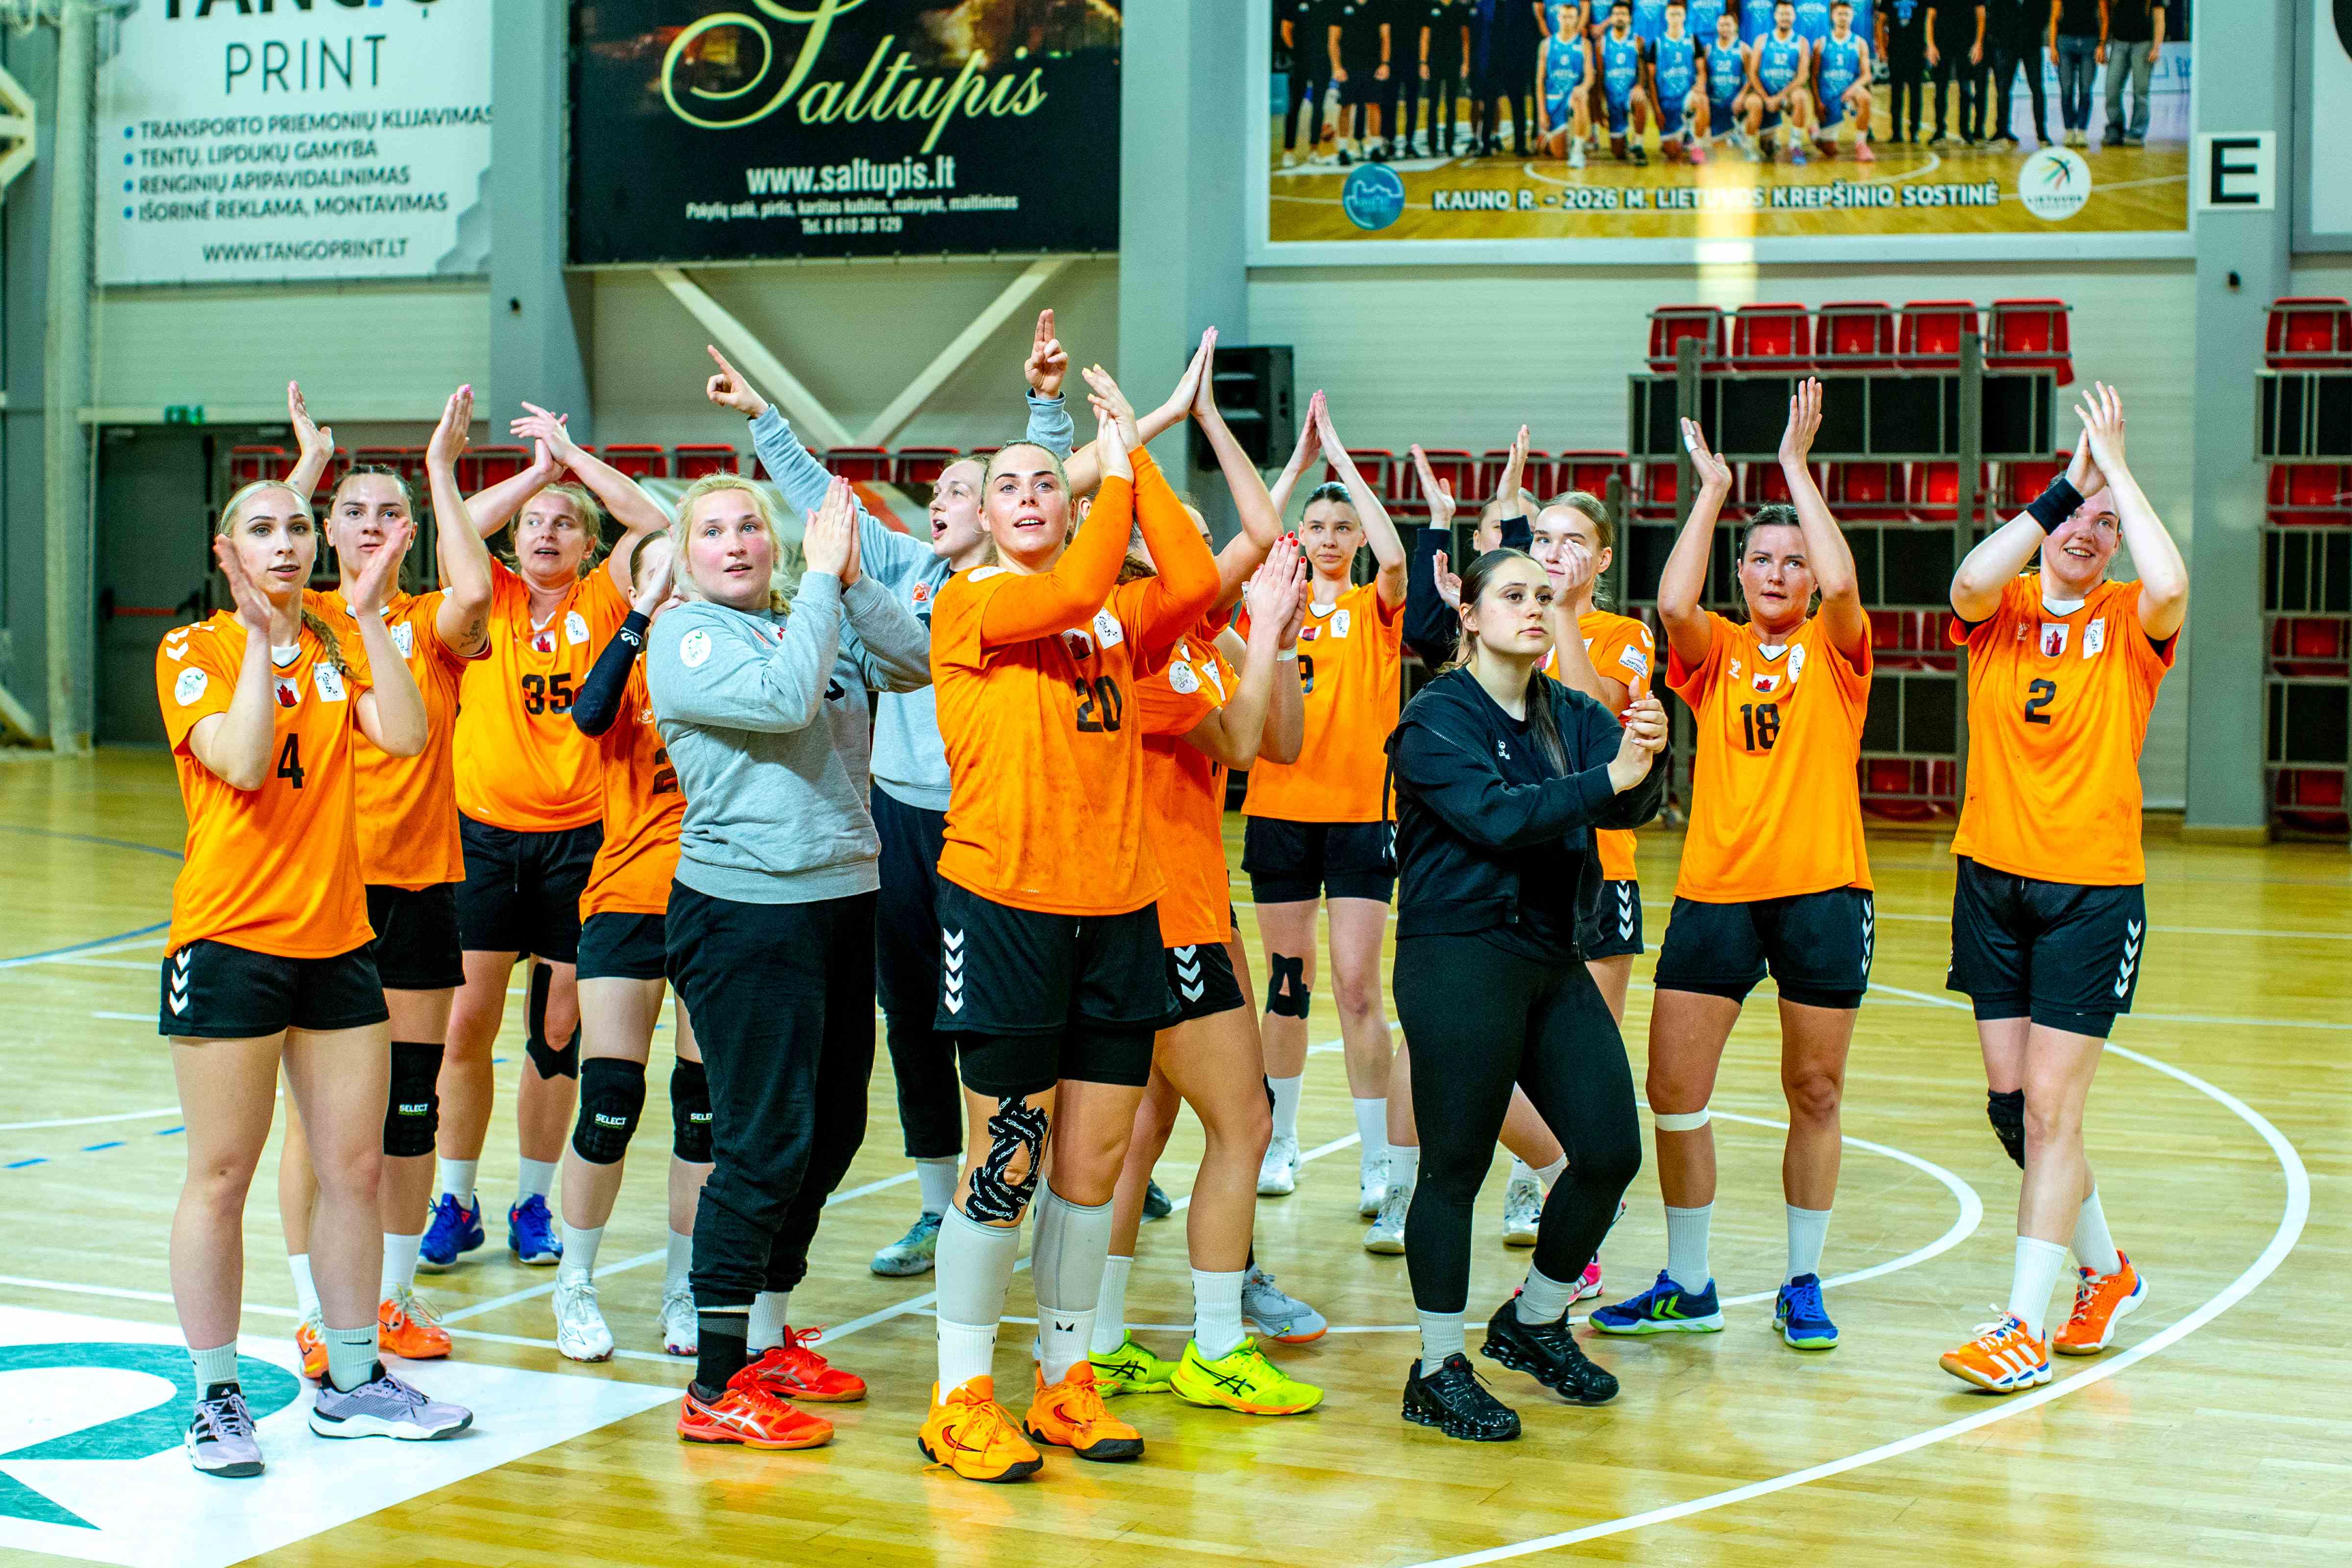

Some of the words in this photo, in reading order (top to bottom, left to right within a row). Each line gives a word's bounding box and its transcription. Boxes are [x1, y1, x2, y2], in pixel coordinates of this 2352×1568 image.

[225, 34, 387, 95] PRINT
[661, 0, 1048, 154] Saltupis
[140, 116, 263, 140] TRANSPORTO
[269, 111, 377, 133] PRIEMONIŲ
[382, 105, 493, 129] KLIJAVIMAS
[208, 143, 289, 164] LIPDUKŲ
[294, 139, 378, 161] GAMYBA
[2209, 137, 2261, 204] E
[140, 173, 227, 195] RENGINIŲ
[232, 165, 411, 191] APIPAVIDALINIMAS
[745, 155, 956, 197] www.saltupis.lt
[1433, 189, 1512, 211] KAUNO
[1518, 189, 1538, 210] R.
[1563, 188, 1618, 209] 2026
[1625, 187, 1648, 208] M.
[1771, 177, 1895, 208] KREPŠINIO
[1901, 176, 2000, 206] SOSTINĖ
[139, 196, 211, 222] IŠORINĖ
[314, 192, 448, 216] MONTAVIMAS
[202, 238, 409, 262] WWW.TANGOPRINT.LT
[522, 672, 573, 715] 35
[1077, 675, 1122, 733] 20
[2025, 678, 2058, 725] 2
[1740, 703, 1781, 751] 18
[277, 733, 305, 789] 4
[400, 1103, 428, 1113] SELECT
[595, 1113, 626, 1125] SELECT
[974, 1200, 1013, 1218] COMPEX
